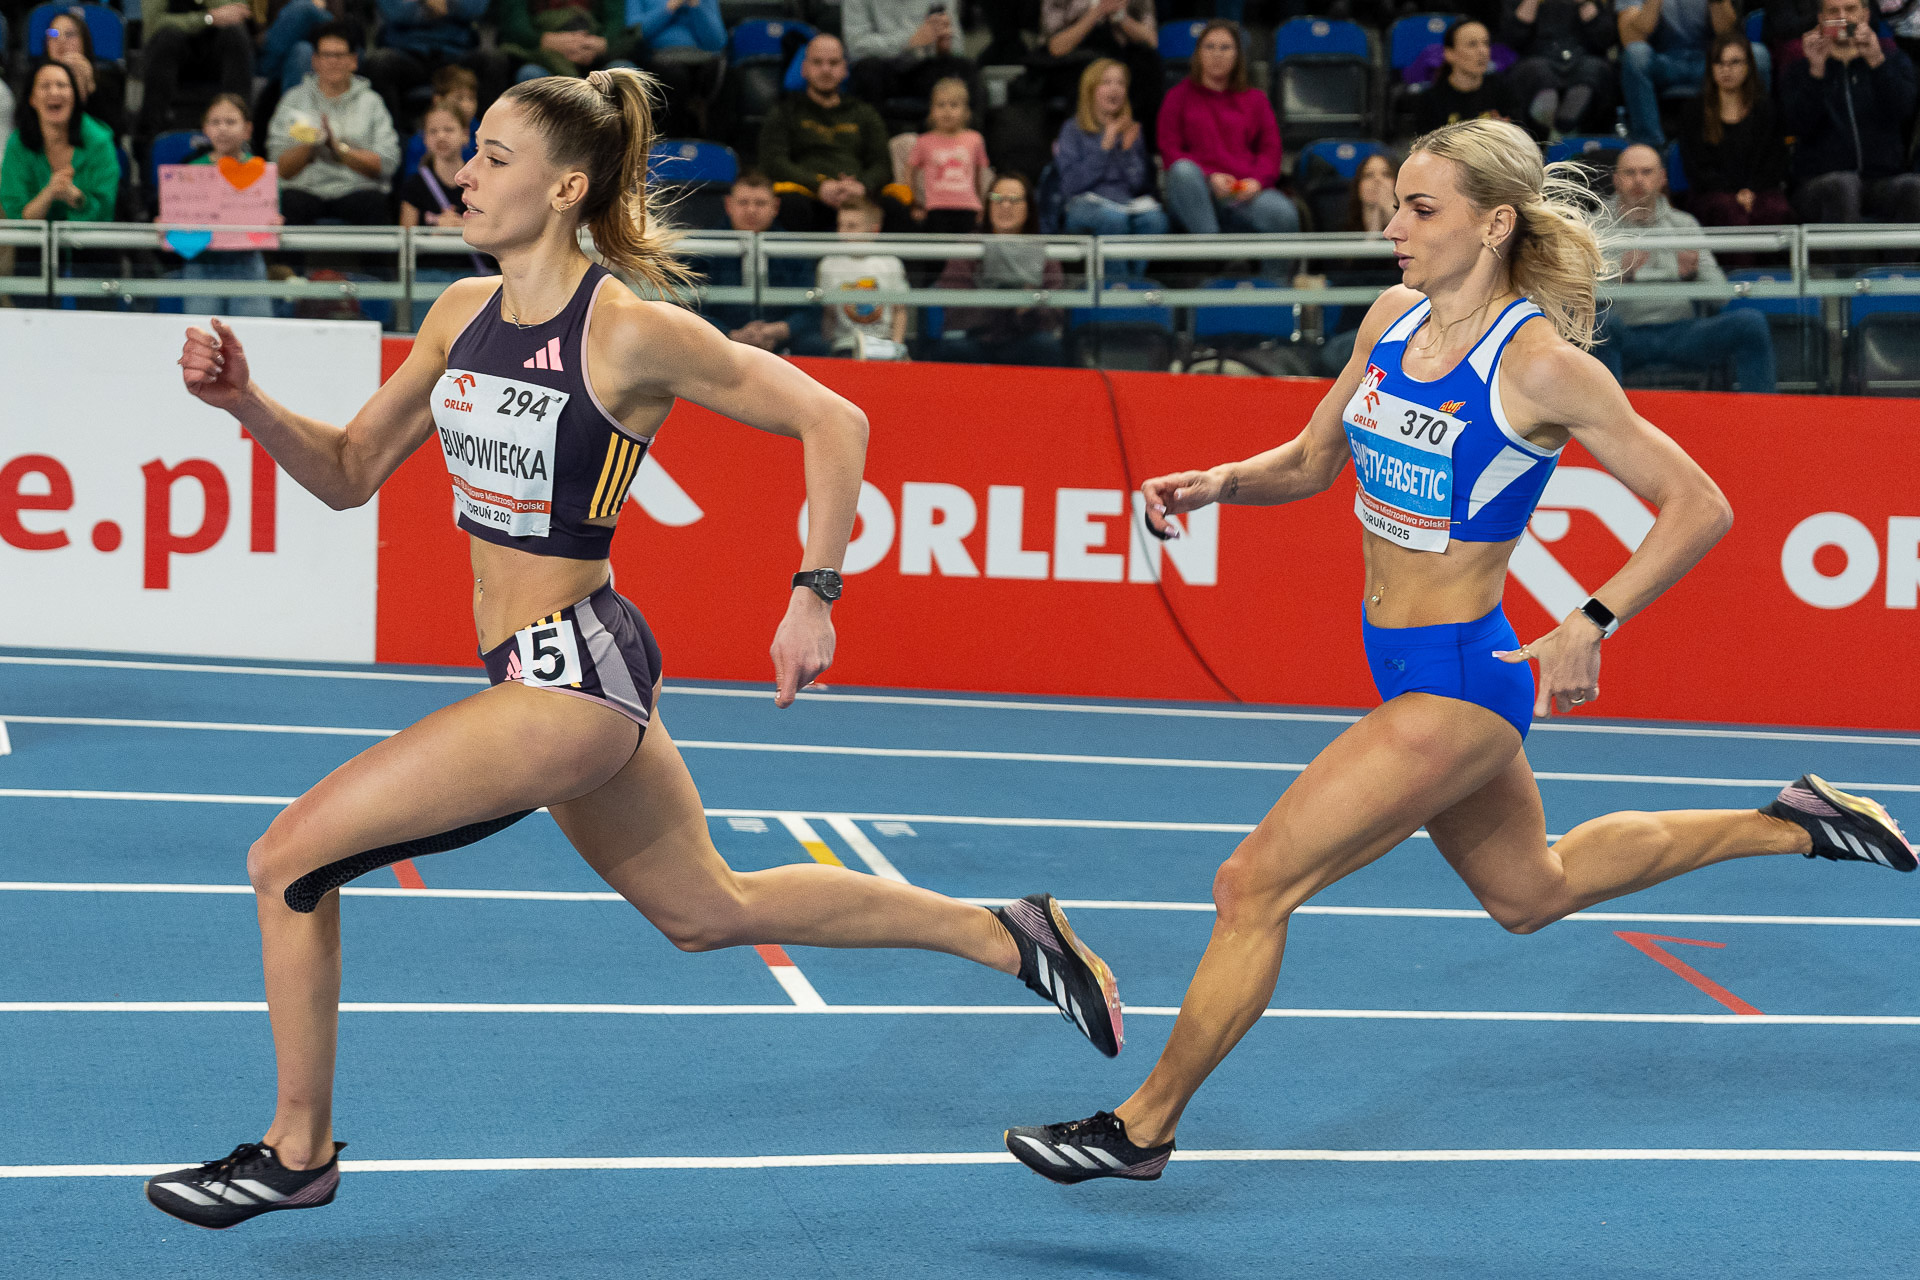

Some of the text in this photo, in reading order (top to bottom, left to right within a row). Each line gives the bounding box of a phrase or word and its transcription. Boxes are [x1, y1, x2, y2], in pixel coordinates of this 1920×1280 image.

[444, 398, 473, 413] ORLEN
[497, 386, 551, 422] 294
[1353, 413, 1378, 430] ORLEN
[1400, 409, 1448, 446] 370
[440, 426, 548, 481] BUKOWIECKA
[516, 502, 545, 511] Polski
[493, 511, 511, 525] 202
[1418, 519, 1446, 528] Polski
[1387, 523, 1410, 541] 2025
[532, 627, 566, 682] 5
